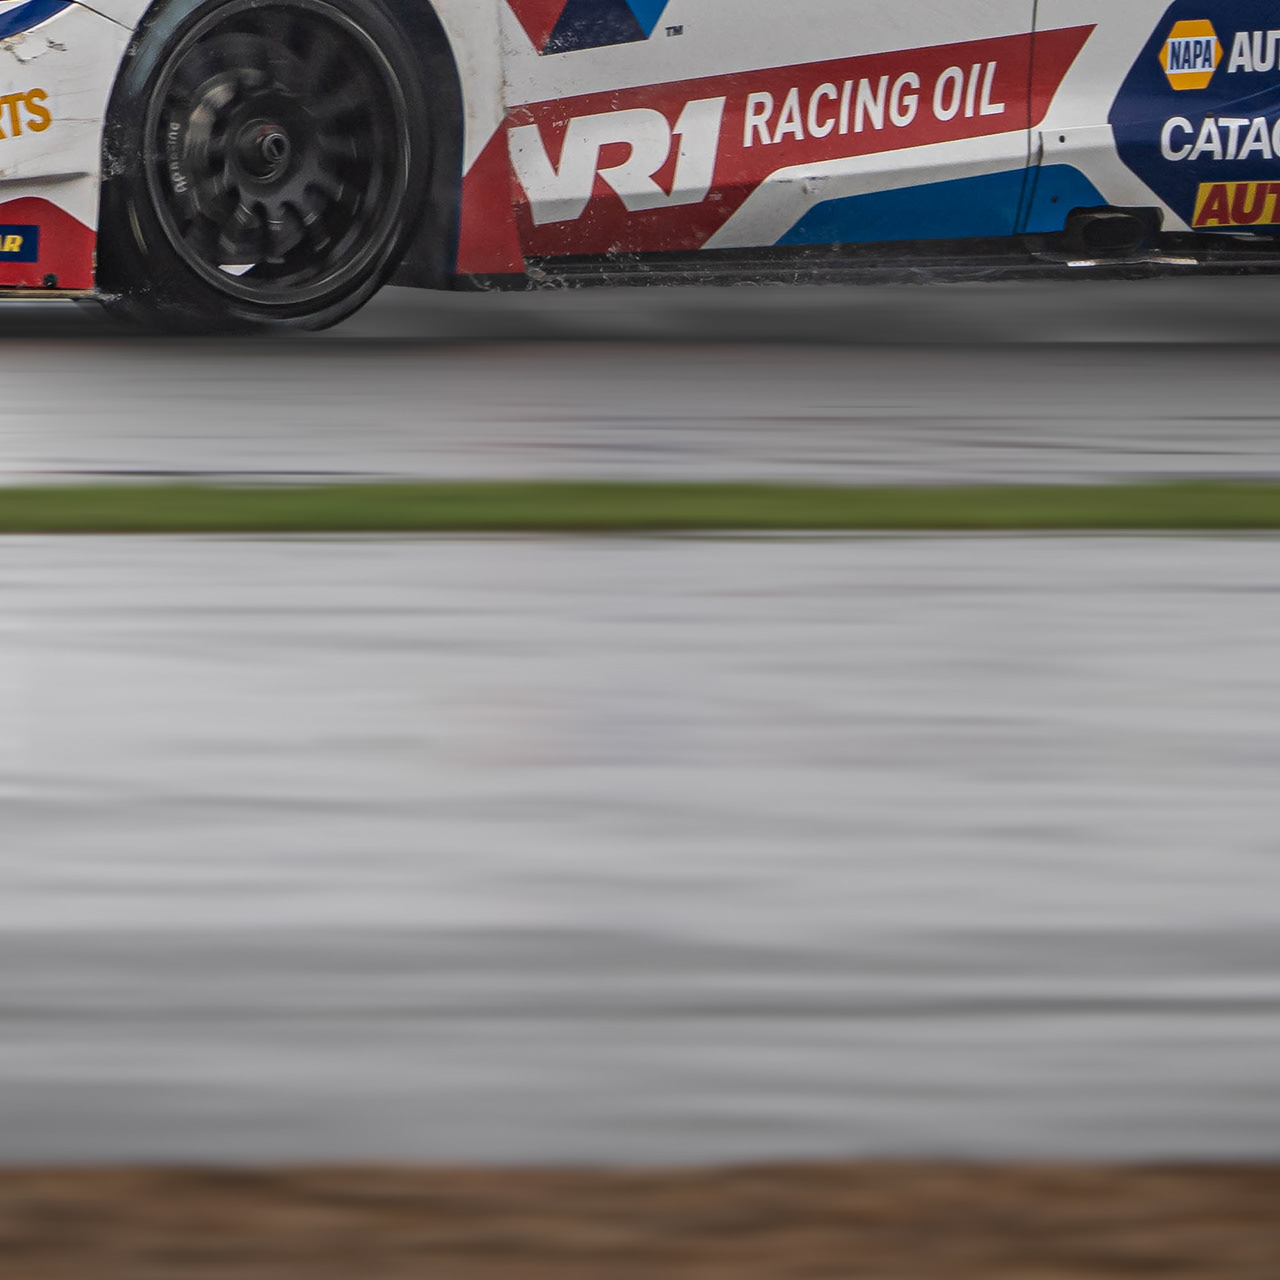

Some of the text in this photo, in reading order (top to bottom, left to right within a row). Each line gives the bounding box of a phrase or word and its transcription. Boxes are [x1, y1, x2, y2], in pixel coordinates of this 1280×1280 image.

[1167, 36, 1214, 72] NAPA
[742, 61, 1005, 148] RACING OIL
[506, 96, 726, 227] VR1
